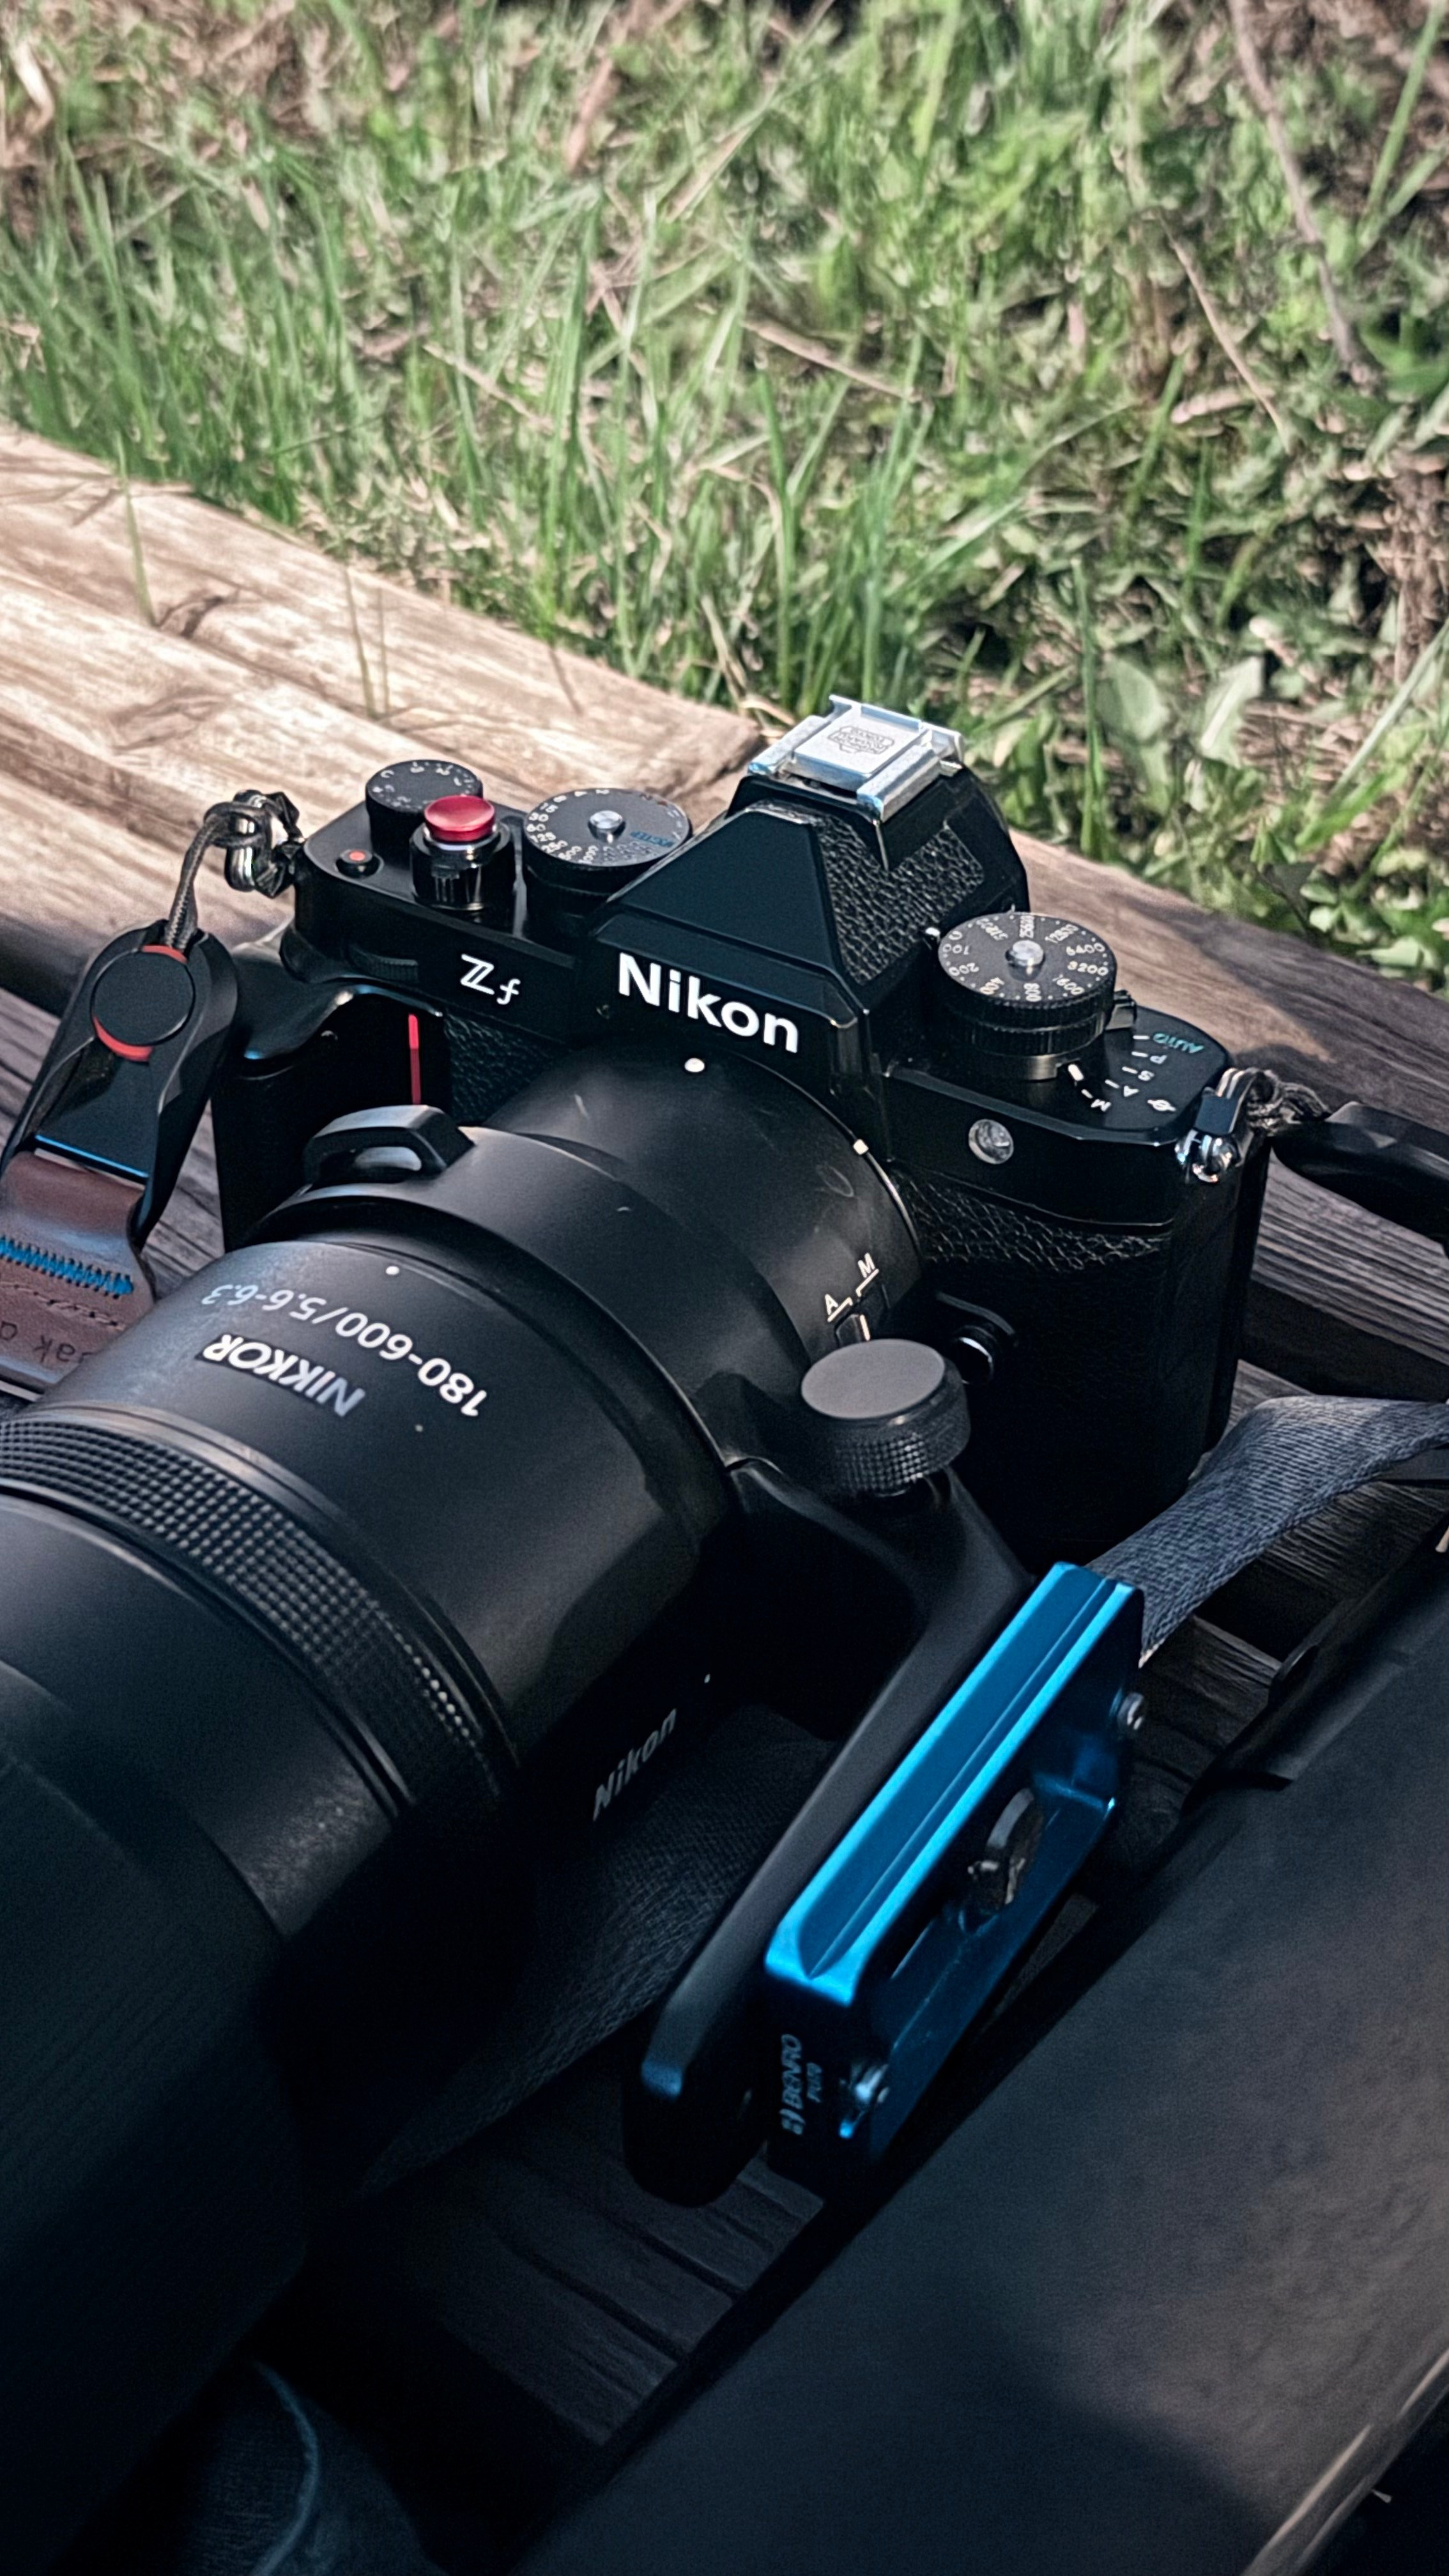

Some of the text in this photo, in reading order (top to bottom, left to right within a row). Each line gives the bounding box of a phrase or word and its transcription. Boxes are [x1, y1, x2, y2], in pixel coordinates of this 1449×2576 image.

[528, 812, 549, 822] 30
[526, 824, 546, 832] 60
[530, 832, 556, 843] 125
[540, 840, 568, 854] 250
[942, 943, 969, 955] 100
[1066, 942, 1105, 956] 6400
[948, 962, 979, 976] 200
[1067, 960, 1109, 976] 3200
[460, 953, 521, 1005] Zf
[979, 977, 1005, 995] 400
[1052, 974, 1085, 995] 1600
[1023, 983, 1043, 1002] 800
[618, 951, 799, 1054] Nikon
[1153, 1032, 1204, 1054] AUTO
[1149, 1054, 1168, 1065] P
[1137, 1070, 1155, 1082] S
[1123, 1085, 1140, 1098] A
[1090, 1098, 1112, 1112] M
[857, 1252, 876, 1278] M
[824, 1294, 838, 1315] A
[201, 1284, 487, 1417] 180-600/5.6-6.3
[202, 1333, 366, 1417] NIKKOR
[592, 1708, 677, 1821] Nikon
[781, 2034, 804, 2110] BENRO
